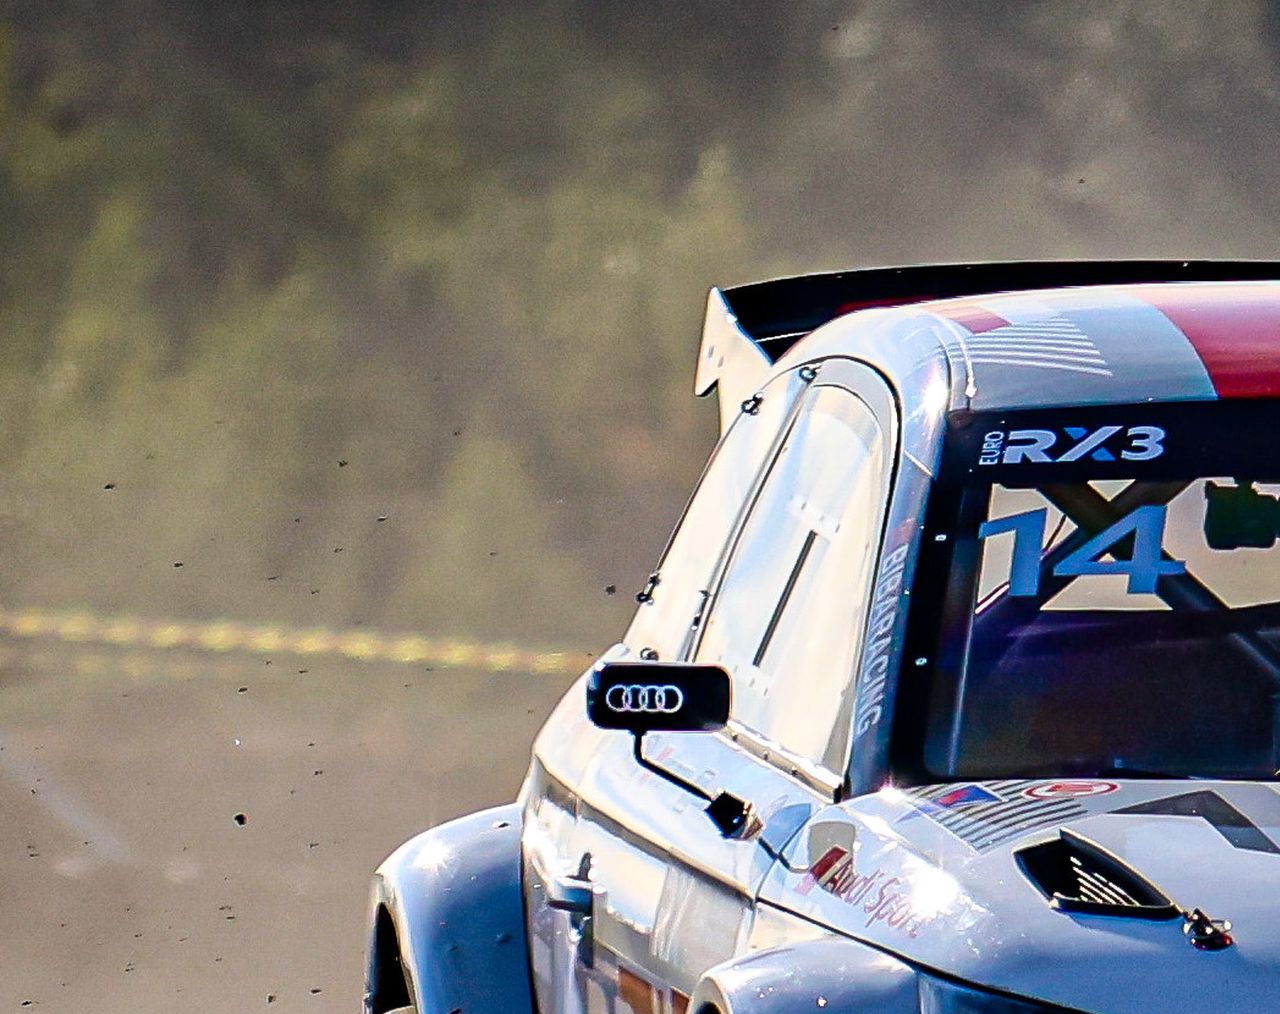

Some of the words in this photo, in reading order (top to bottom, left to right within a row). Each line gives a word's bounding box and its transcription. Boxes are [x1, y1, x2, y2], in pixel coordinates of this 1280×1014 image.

[979, 431, 1005, 465] EURO
[1003, 426, 1167, 464] RX3
[978, 505, 1186, 596] 14
